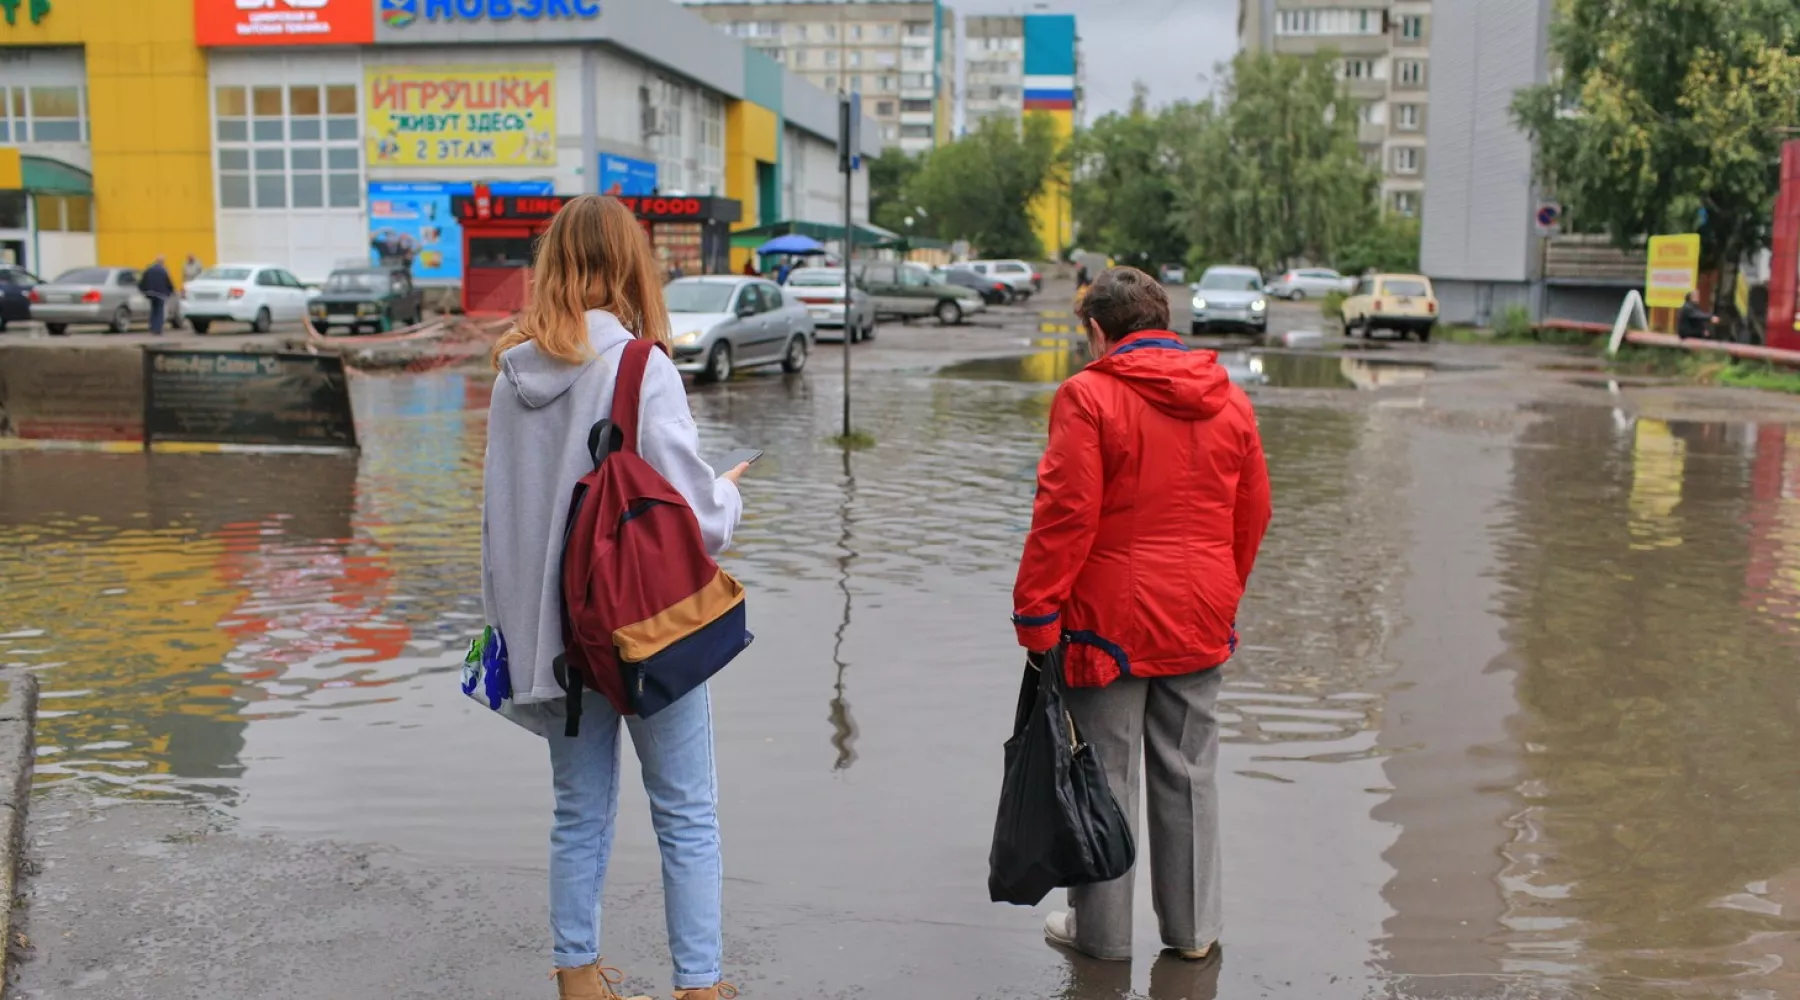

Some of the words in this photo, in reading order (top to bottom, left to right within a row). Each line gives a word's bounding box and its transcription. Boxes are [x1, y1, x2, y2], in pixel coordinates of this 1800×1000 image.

[372, 79, 550, 110] ИГРУШКИ
[416, 140, 428, 159] 2
[437, 140, 496, 159] ЭТАЖ
[641, 198, 700, 214] FOOD
